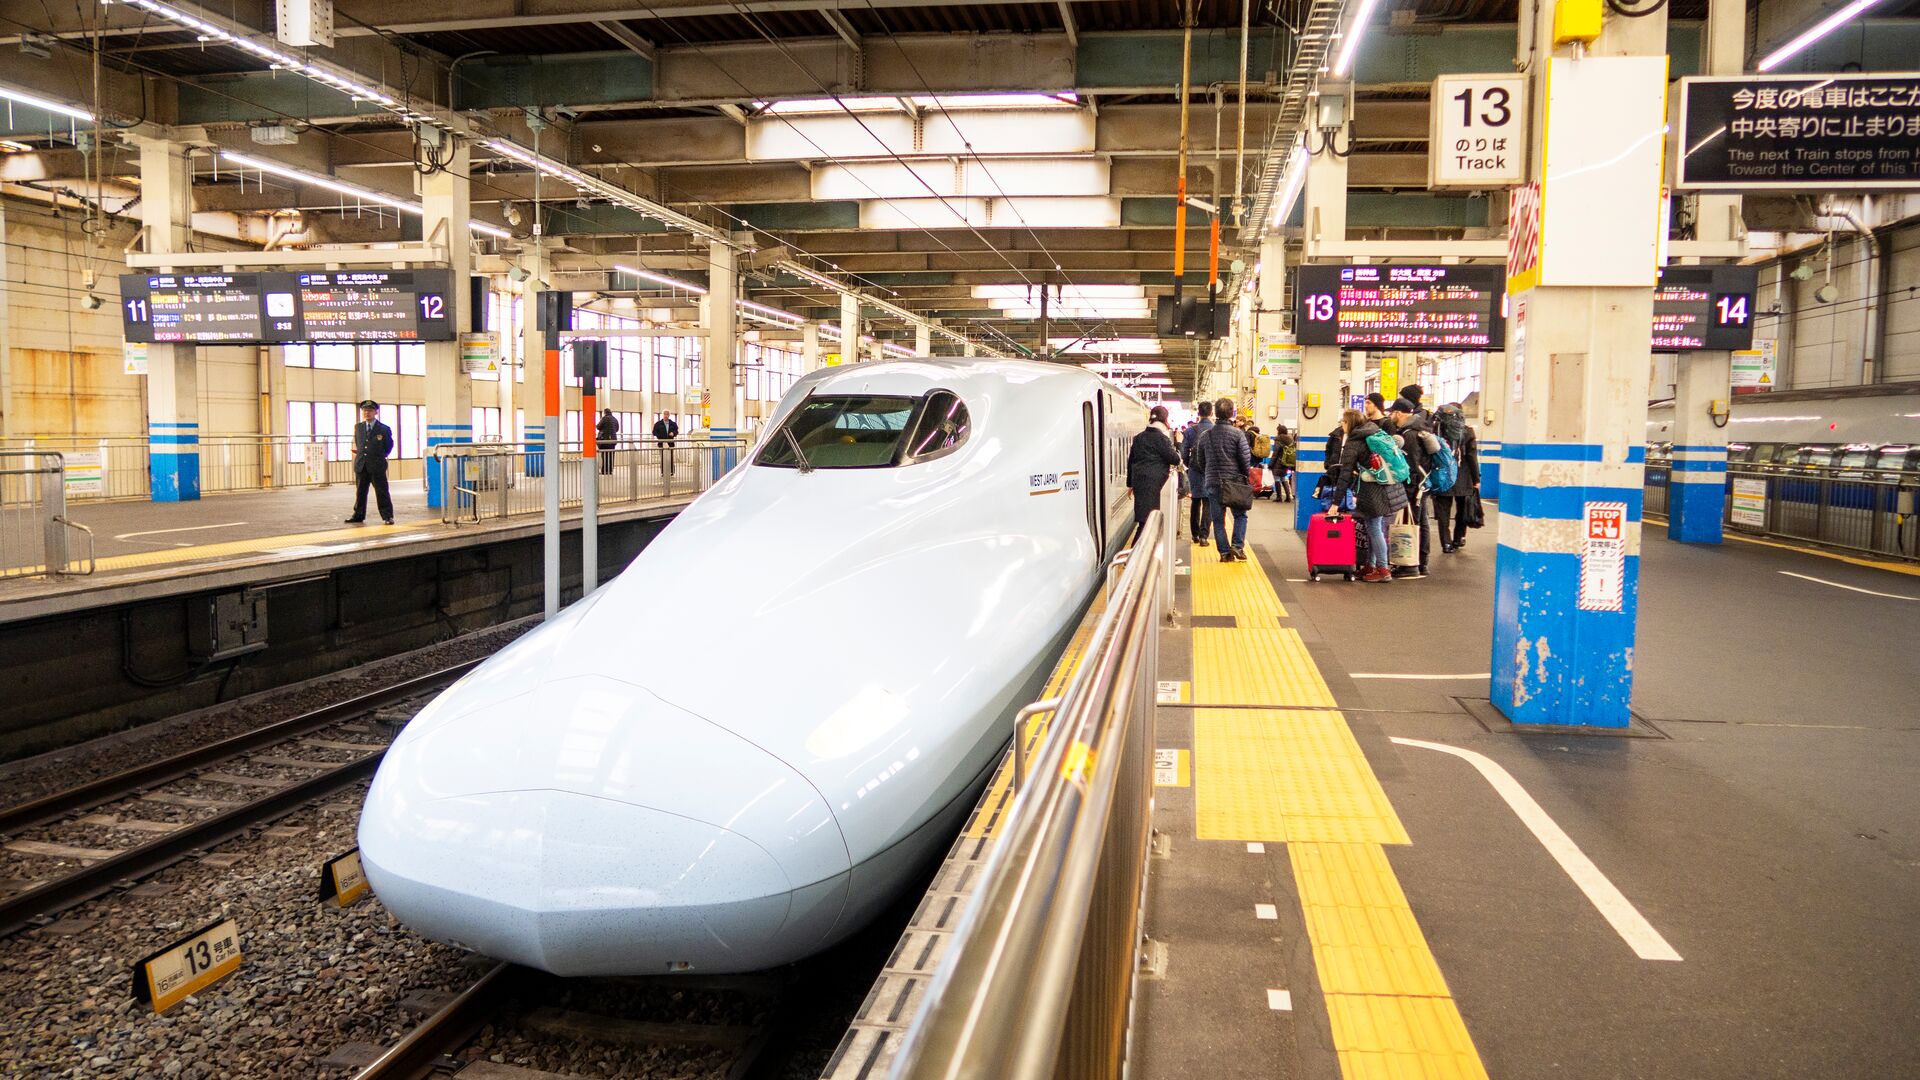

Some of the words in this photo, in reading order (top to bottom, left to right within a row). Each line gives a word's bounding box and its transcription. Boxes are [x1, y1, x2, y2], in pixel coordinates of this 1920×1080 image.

[1454, 87, 1511, 127] 13
[1456, 138, 1507, 151] のりば
[1456, 155, 1506, 170] Track
[1728, 149, 1754, 161] The
[1759, 150, 1789, 161] next
[1794, 148, 1829, 161] Train
[1835, 148, 1873, 162] stops
[1878, 147, 1910, 159] from
[1727, 162, 1776, 176] Toward
[1782, 162, 1804, 175] the
[1809, 162, 1856, 175] Center
[1861, 161, 1875, 174] of
[1880, 161, 1907, 174] this
[127, 299, 147, 322] 11
[420, 296, 444, 318] 12
[1305, 295, 1334, 321] 13
[1716, 296, 1747, 323] 14
[1029, 474, 1042, 487] WEST
[1044, 473, 1058, 485] JAPAN
[1591, 510, 1619, 519] STOP
[213, 936, 233, 954] 号車
[184, 940, 211, 975] 13
[215, 953, 226, 963] Car
[227, 947, 237, 958] No.
[157, 980, 169, 992] 16
